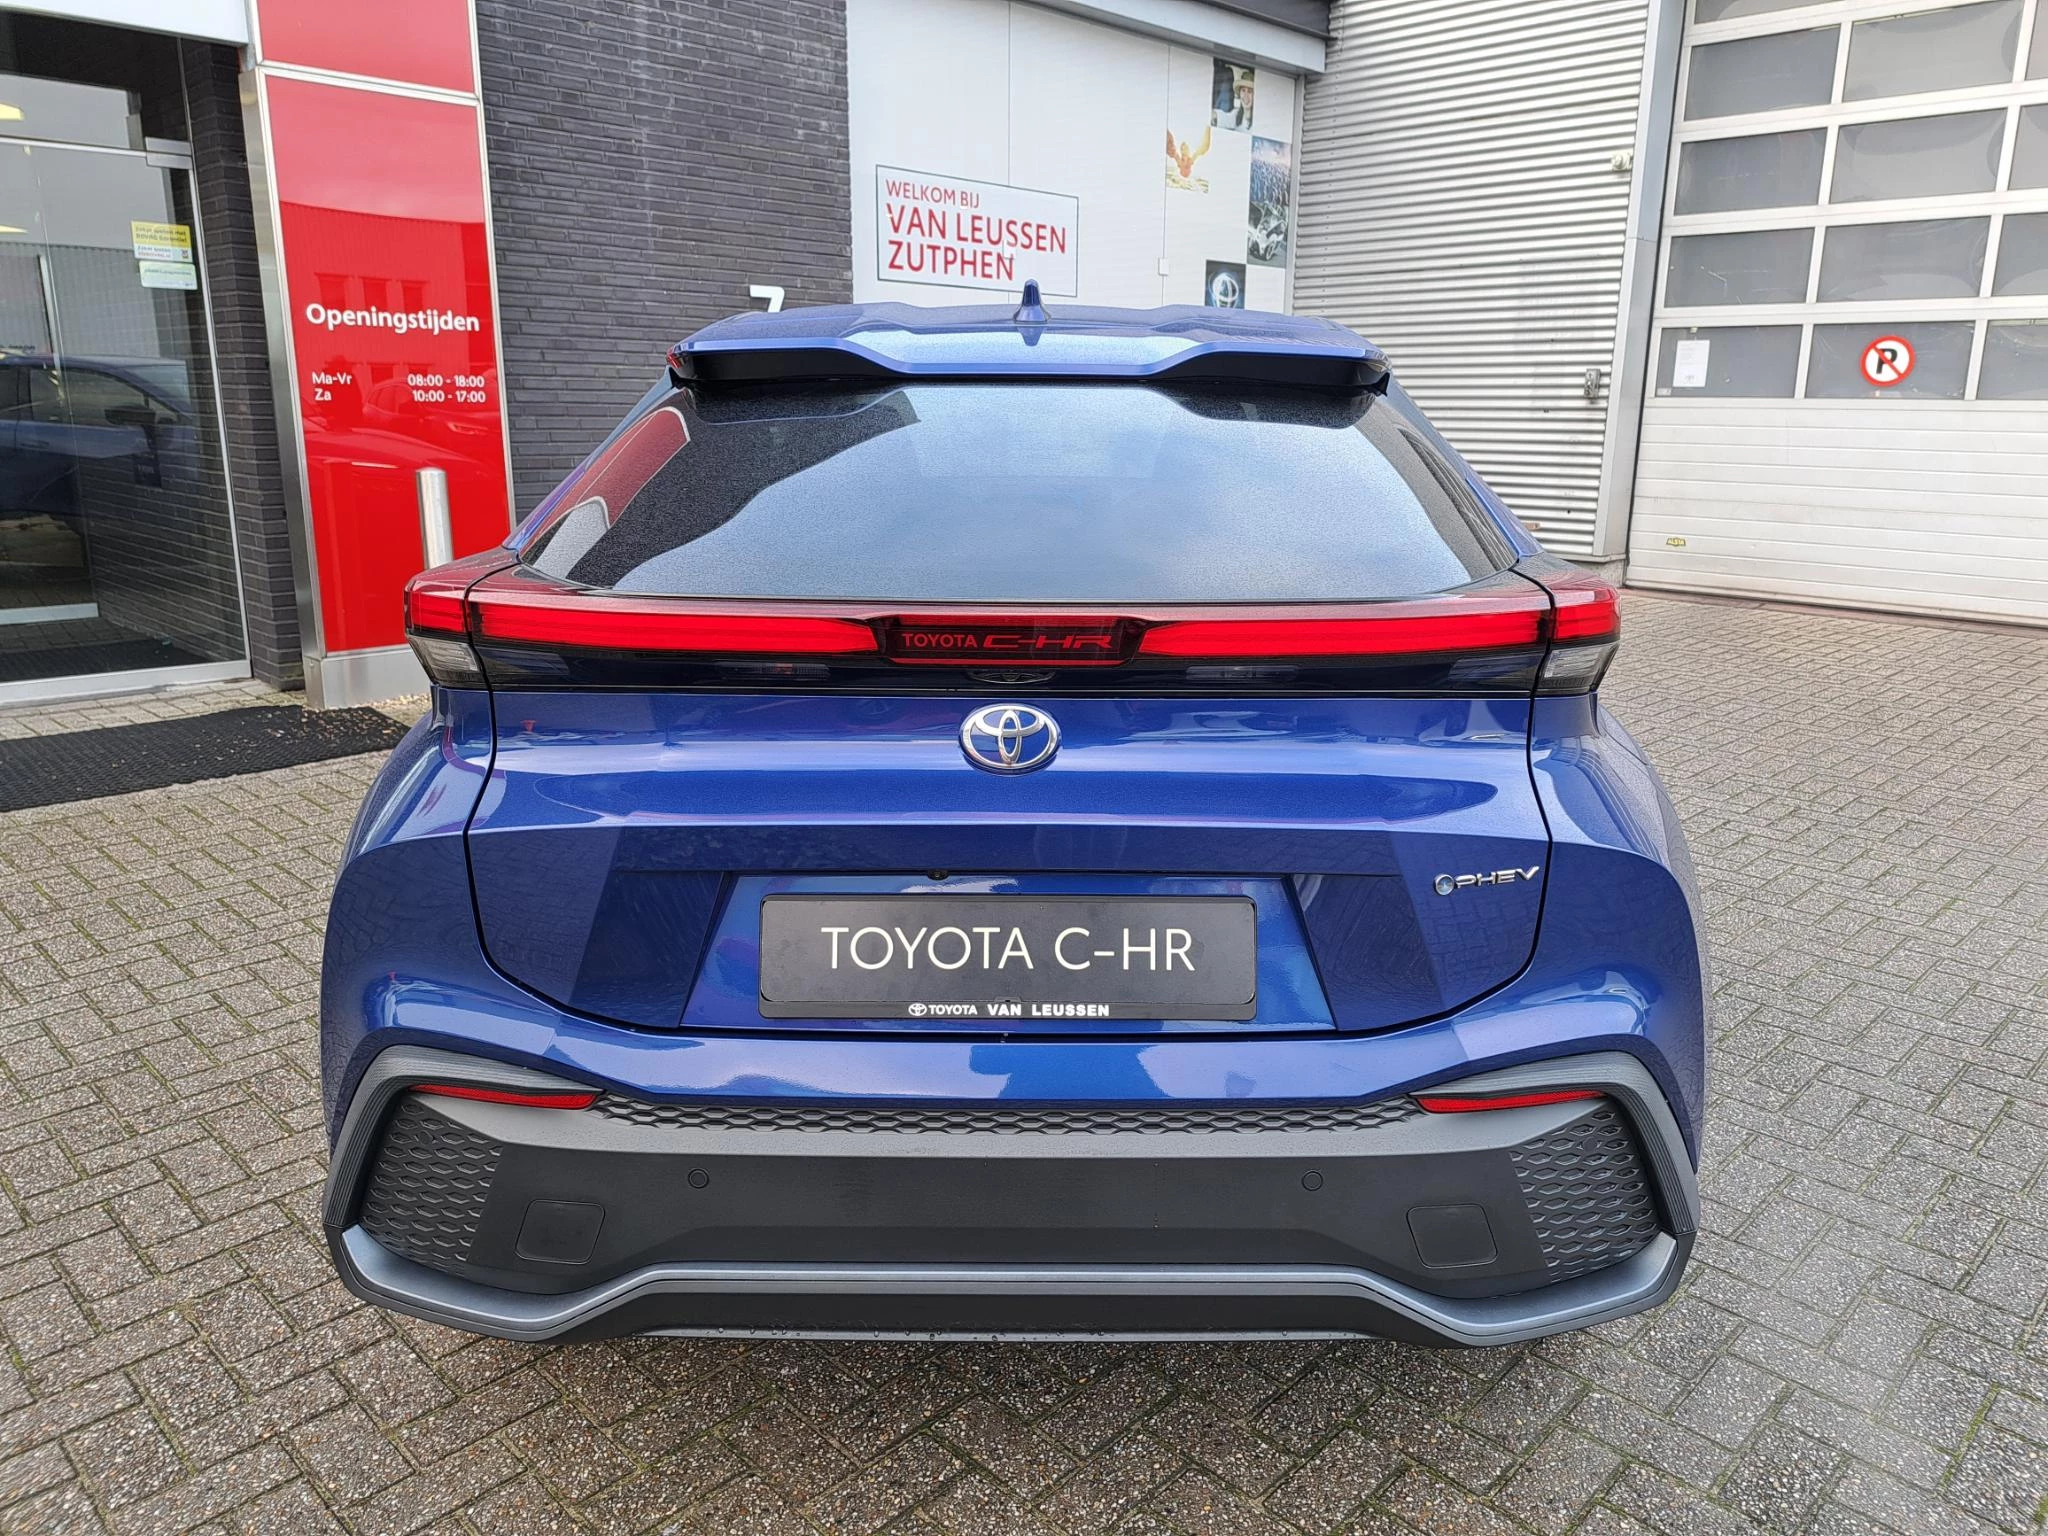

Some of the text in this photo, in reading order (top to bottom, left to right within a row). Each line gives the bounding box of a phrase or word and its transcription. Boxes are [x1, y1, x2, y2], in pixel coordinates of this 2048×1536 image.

[885, 178, 980, 209] WELKOM BIJ
[886, 203, 1067, 254] VAN LEUSSEN
[887, 239, 1014, 282] ZUTPHEN
[749, 284, 785, 313] 7
[306, 303, 480, 335] Openingstijden
[1875, 347, 1898, 375] P
[311, 371, 353, 386] Ma-Vr
[407, 373, 443, 388] 08:00
[453, 374, 485, 388] 18:00
[314, 387, 332, 401] Za
[412, 389, 445, 403] 10:00
[455, 390, 487, 403] 17:00
[902, 632, 1113, 649] TOYOTA C-HR
[1456, 865, 1540, 889] PHEV
[821, 925, 1196, 971] TOYOTA C-HR
[928, 1003, 1110, 1017] TOYOTA VAN LEUSSEN
